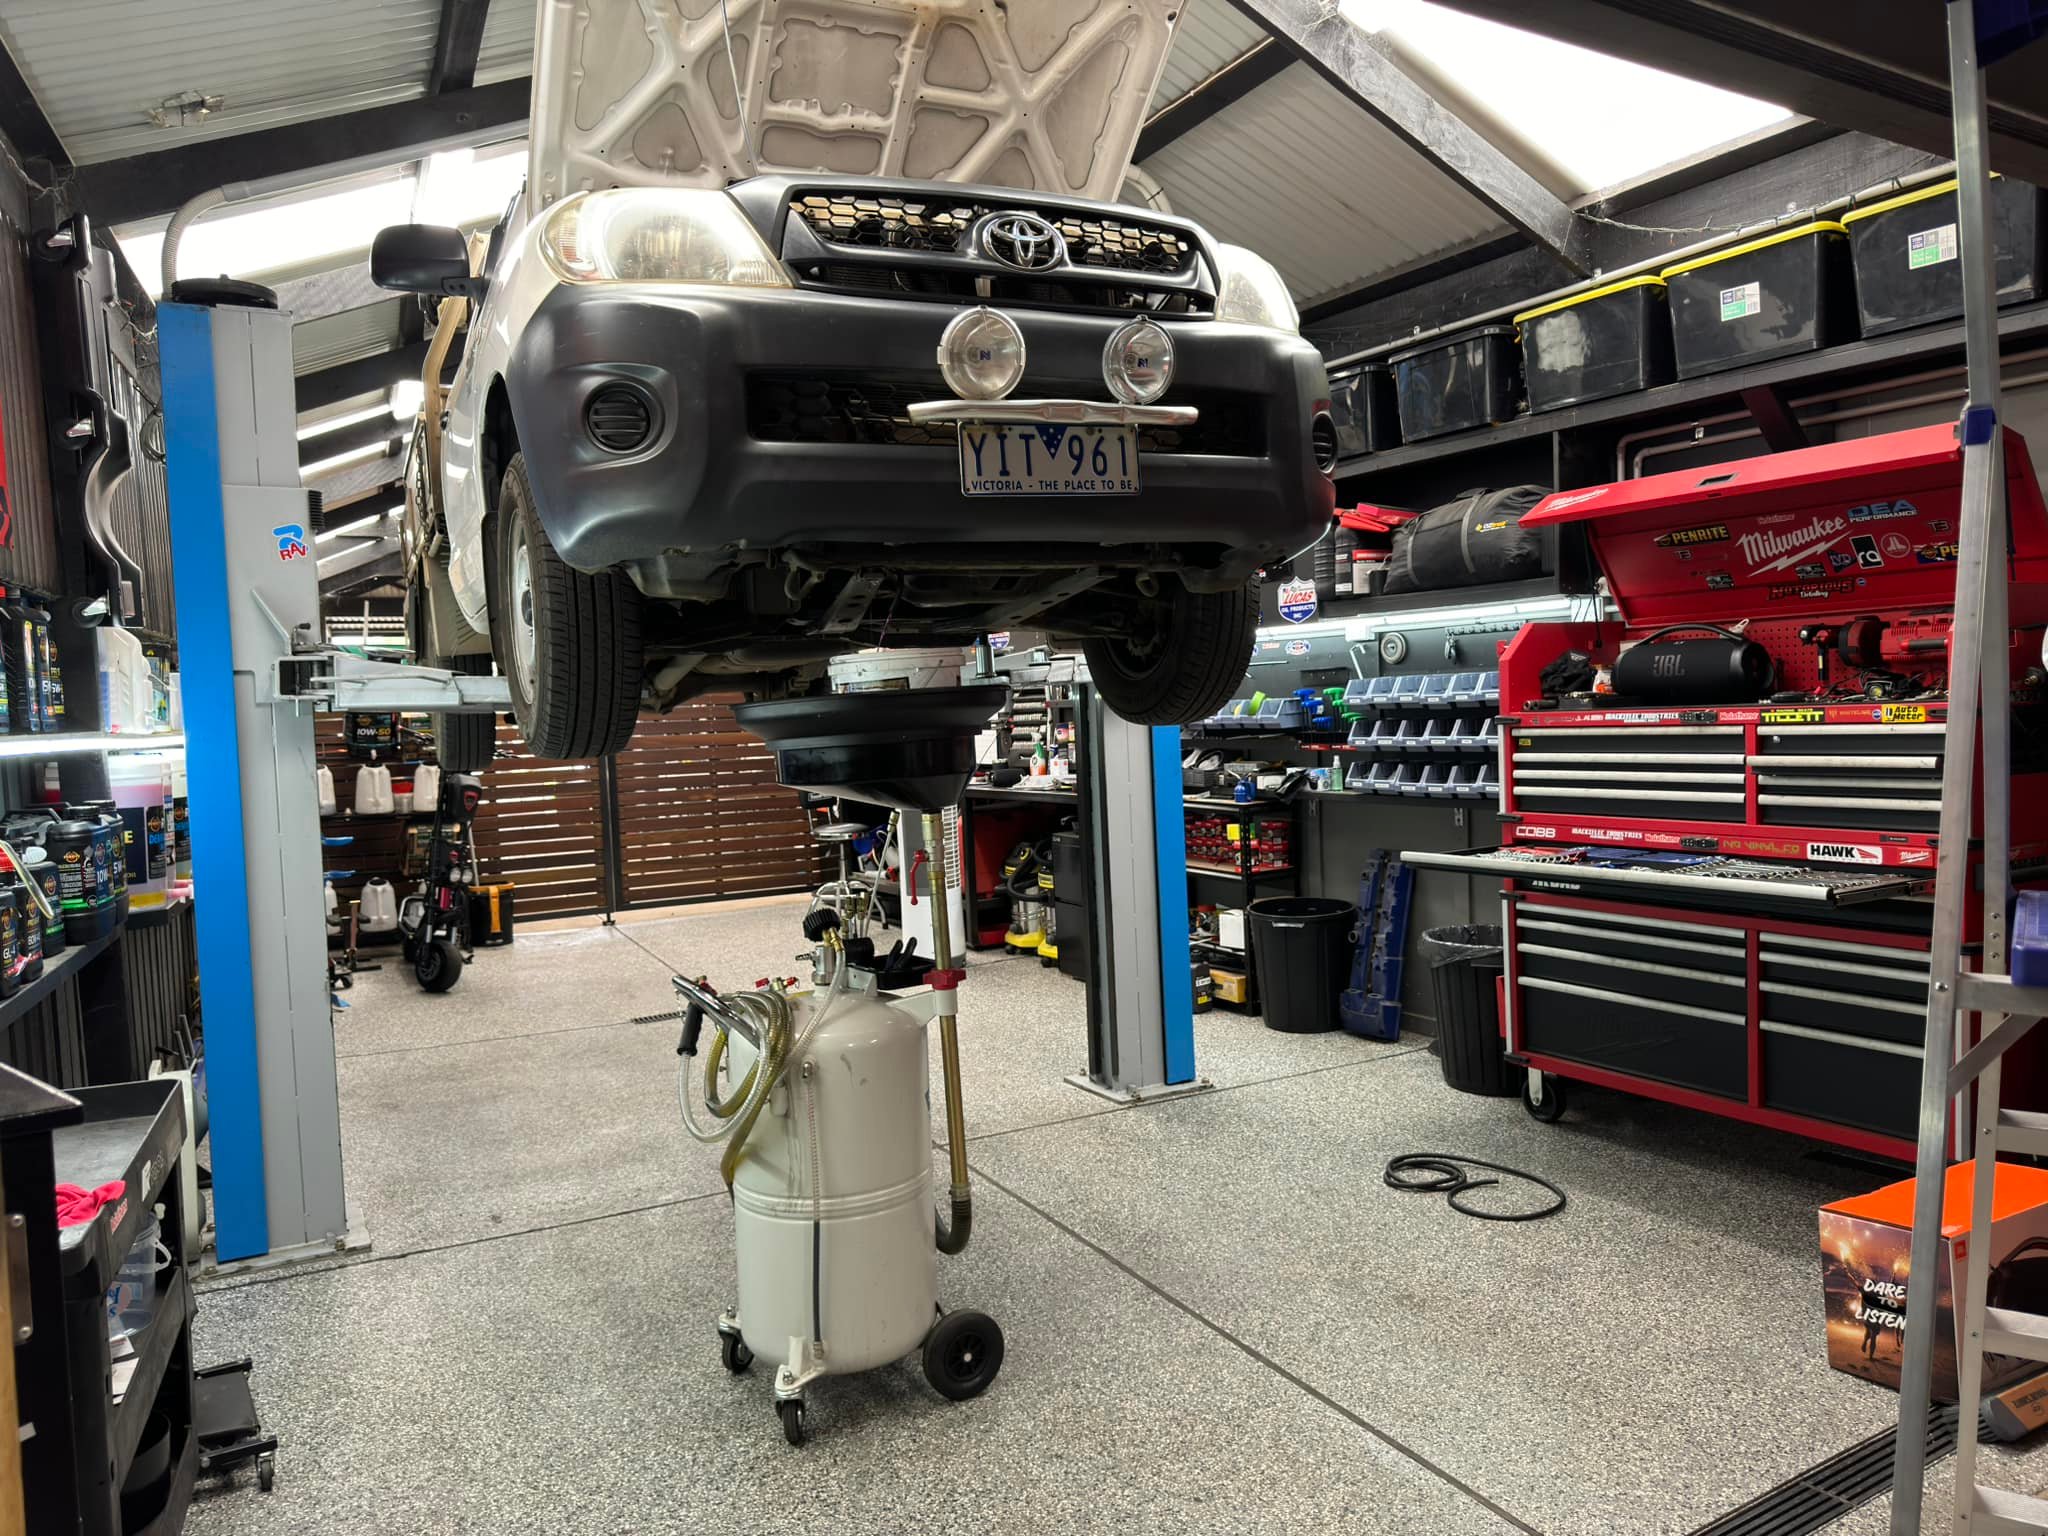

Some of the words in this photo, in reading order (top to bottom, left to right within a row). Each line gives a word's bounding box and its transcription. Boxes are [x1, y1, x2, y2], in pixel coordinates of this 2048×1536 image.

[968, 433, 1034, 477] YIT
[1068, 435, 1128, 477] 961
[972, 480, 1023, 491] VICTORIA
[1039, 480, 1058, 490] THE
[1064, 480, 1096, 490] PLACE
[1102, 480, 1114, 490] TO
[1121, 479, 1133, 490] BE
[1850, 509, 1919, 523] PERFORMANCE
[1672, 526, 1729, 544] PENRITE
[1736, 515, 1848, 567] Milwaukee
[279, 542, 307, 560] RAV
[1283, 591, 1314, 604] LUCAS
[1653, 654, 1685, 677] JBL
[1894, 705, 1918, 713] Auto
[1892, 712, 1924, 721] Meter
[1515, 826, 1556, 838] COBB
[1810, 844, 1856, 858] HAWK
[1863, 1278, 1907, 1300] DARE
[1877, 1296, 1899, 1309] TO
[1855, 1308, 1908, 1330] LISTEN
